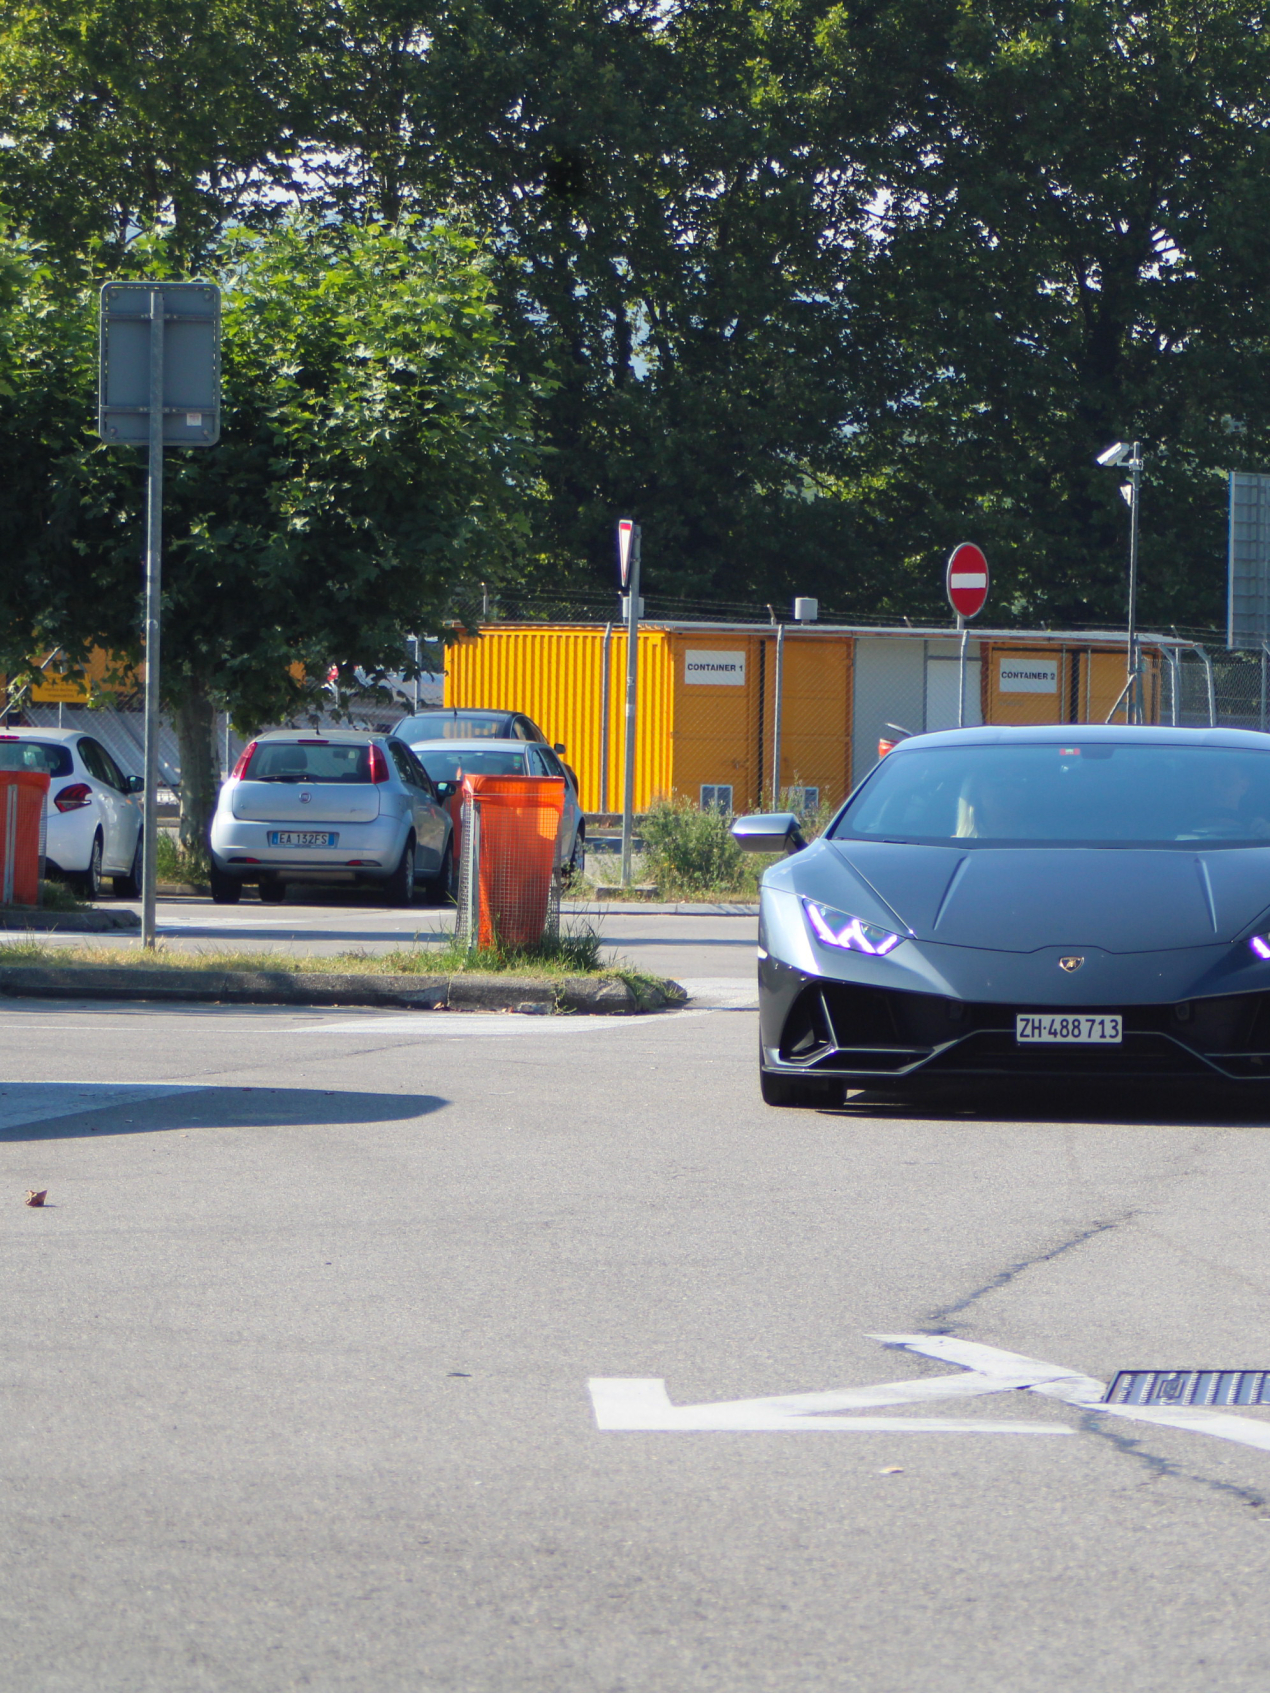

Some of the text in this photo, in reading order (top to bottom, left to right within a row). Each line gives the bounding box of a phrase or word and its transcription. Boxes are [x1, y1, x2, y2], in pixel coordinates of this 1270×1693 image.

[687, 663, 736, 672] CONTAINER
[1001, 671, 1048, 680] CONTAINER
[280, 833, 327, 844] EA 132FS
